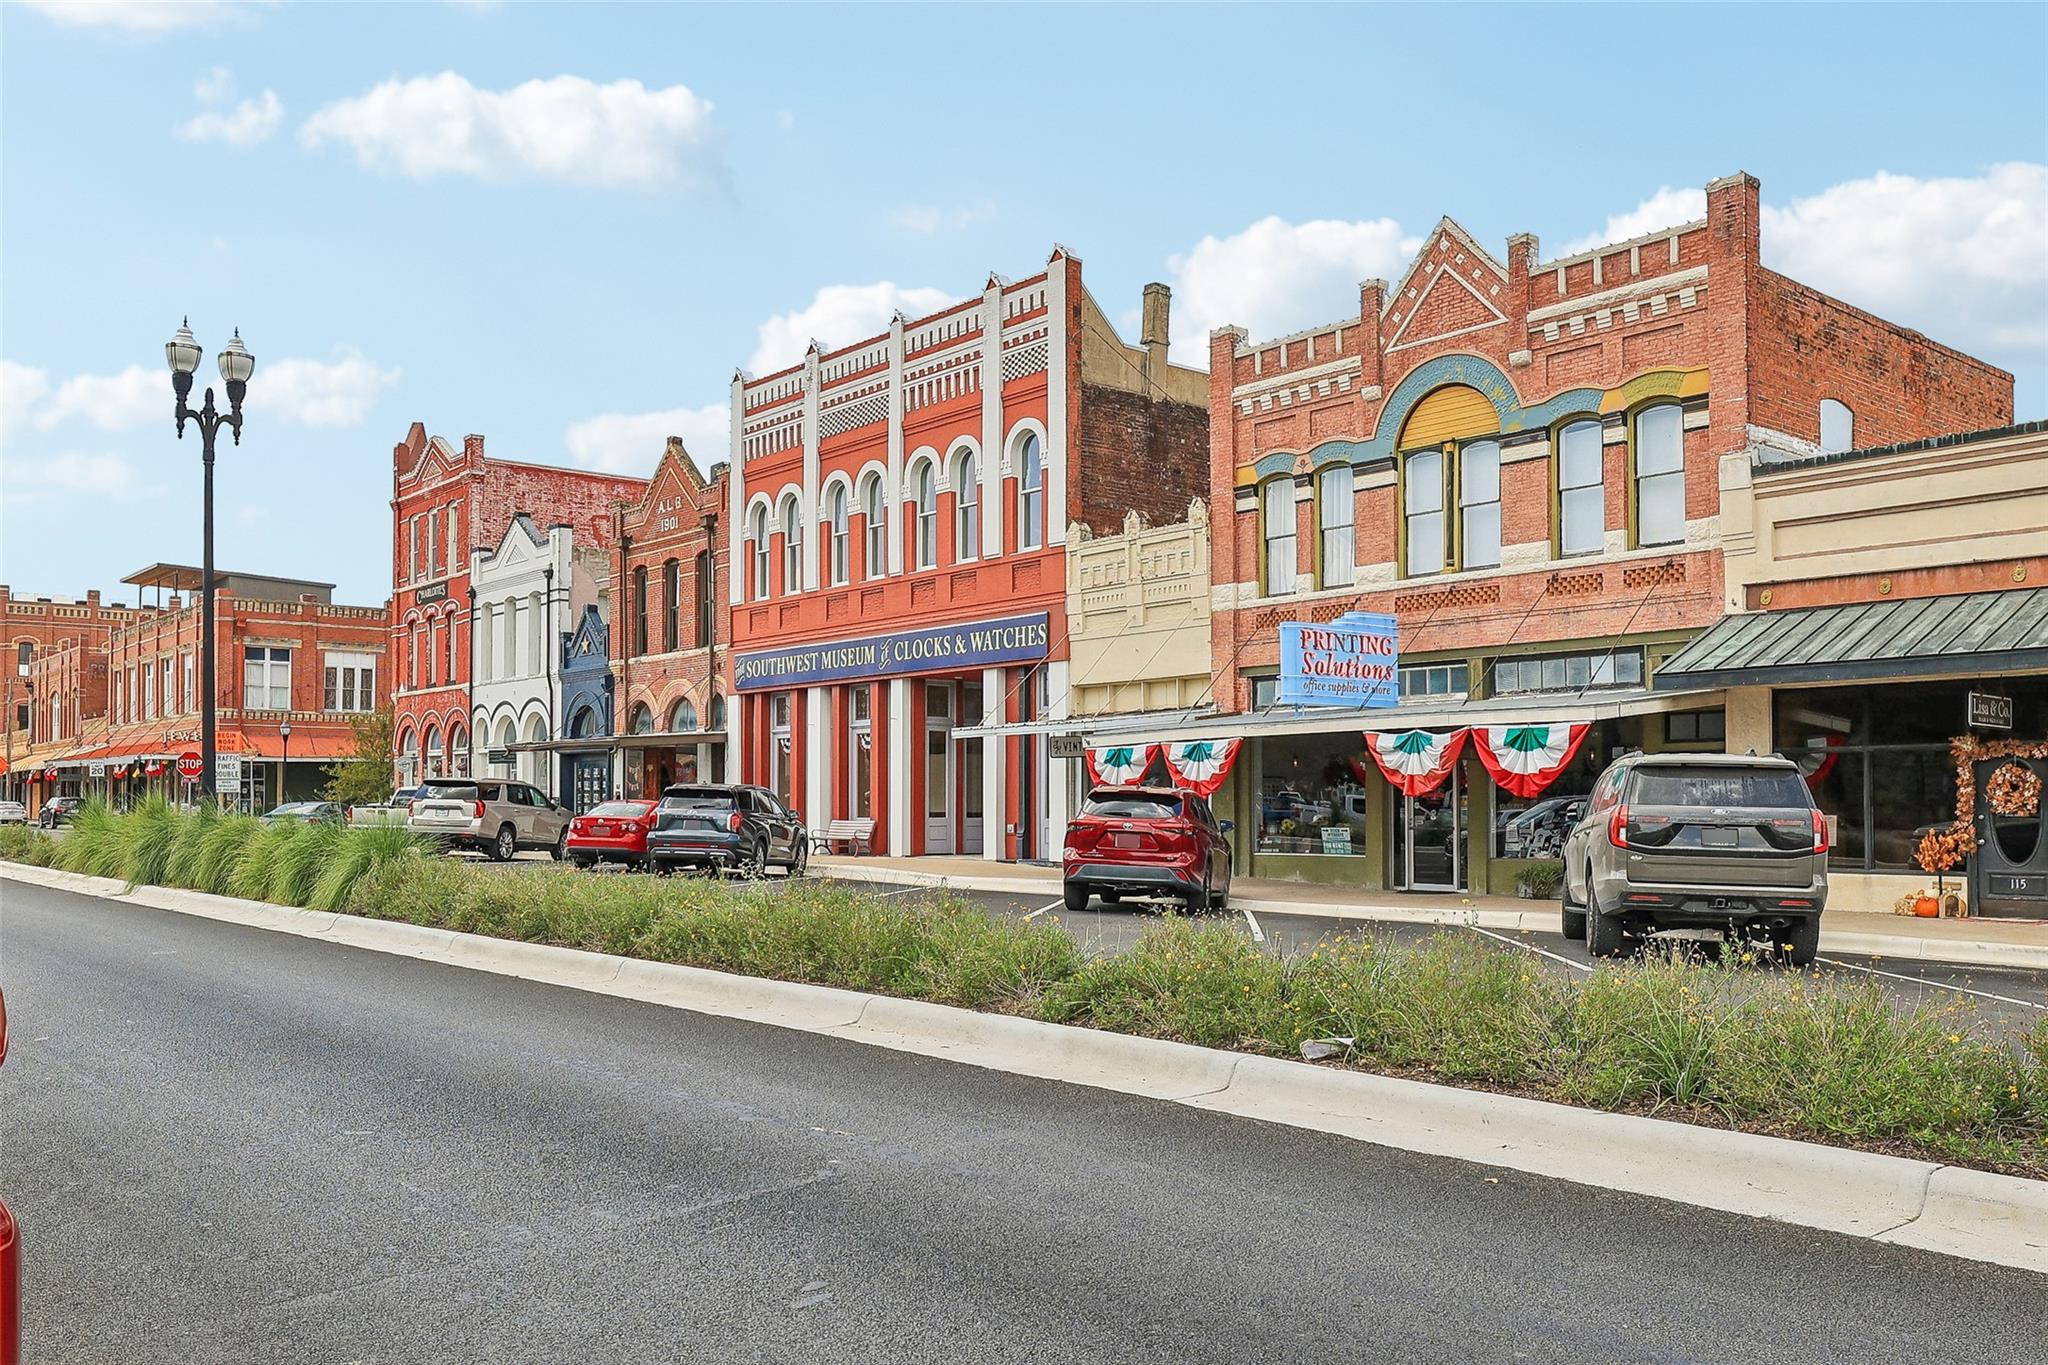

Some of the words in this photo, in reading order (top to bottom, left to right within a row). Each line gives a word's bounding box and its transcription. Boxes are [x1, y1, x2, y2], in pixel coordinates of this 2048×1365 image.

[660, 515, 678, 532] 1901
[746, 652, 819, 678] SOUTHWEST
[821, 645, 876, 670] MUSEUM
[894, 635, 951, 661] CLOCKS
[955, 633, 967, 655] &
[970, 623, 1047, 652] WATCHES
[1300, 629, 1393, 656] PRINTING
[1301, 651, 1394, 681] Solutions
[1303, 678, 1326, 694] office
[1327, 682, 1359, 696] supplies
[1361, 683, 1371, 694] &
[1973, 698, 1989, 715] Lisa
[1990, 700, 1998, 716] &
[162, 730, 202, 744] JEWE
[1062, 741, 1083, 752] VINT
[178, 759, 203, 769] STOP
[217, 754, 241, 762] RAFFIC
[2011, 879, 2026, 890] 115
